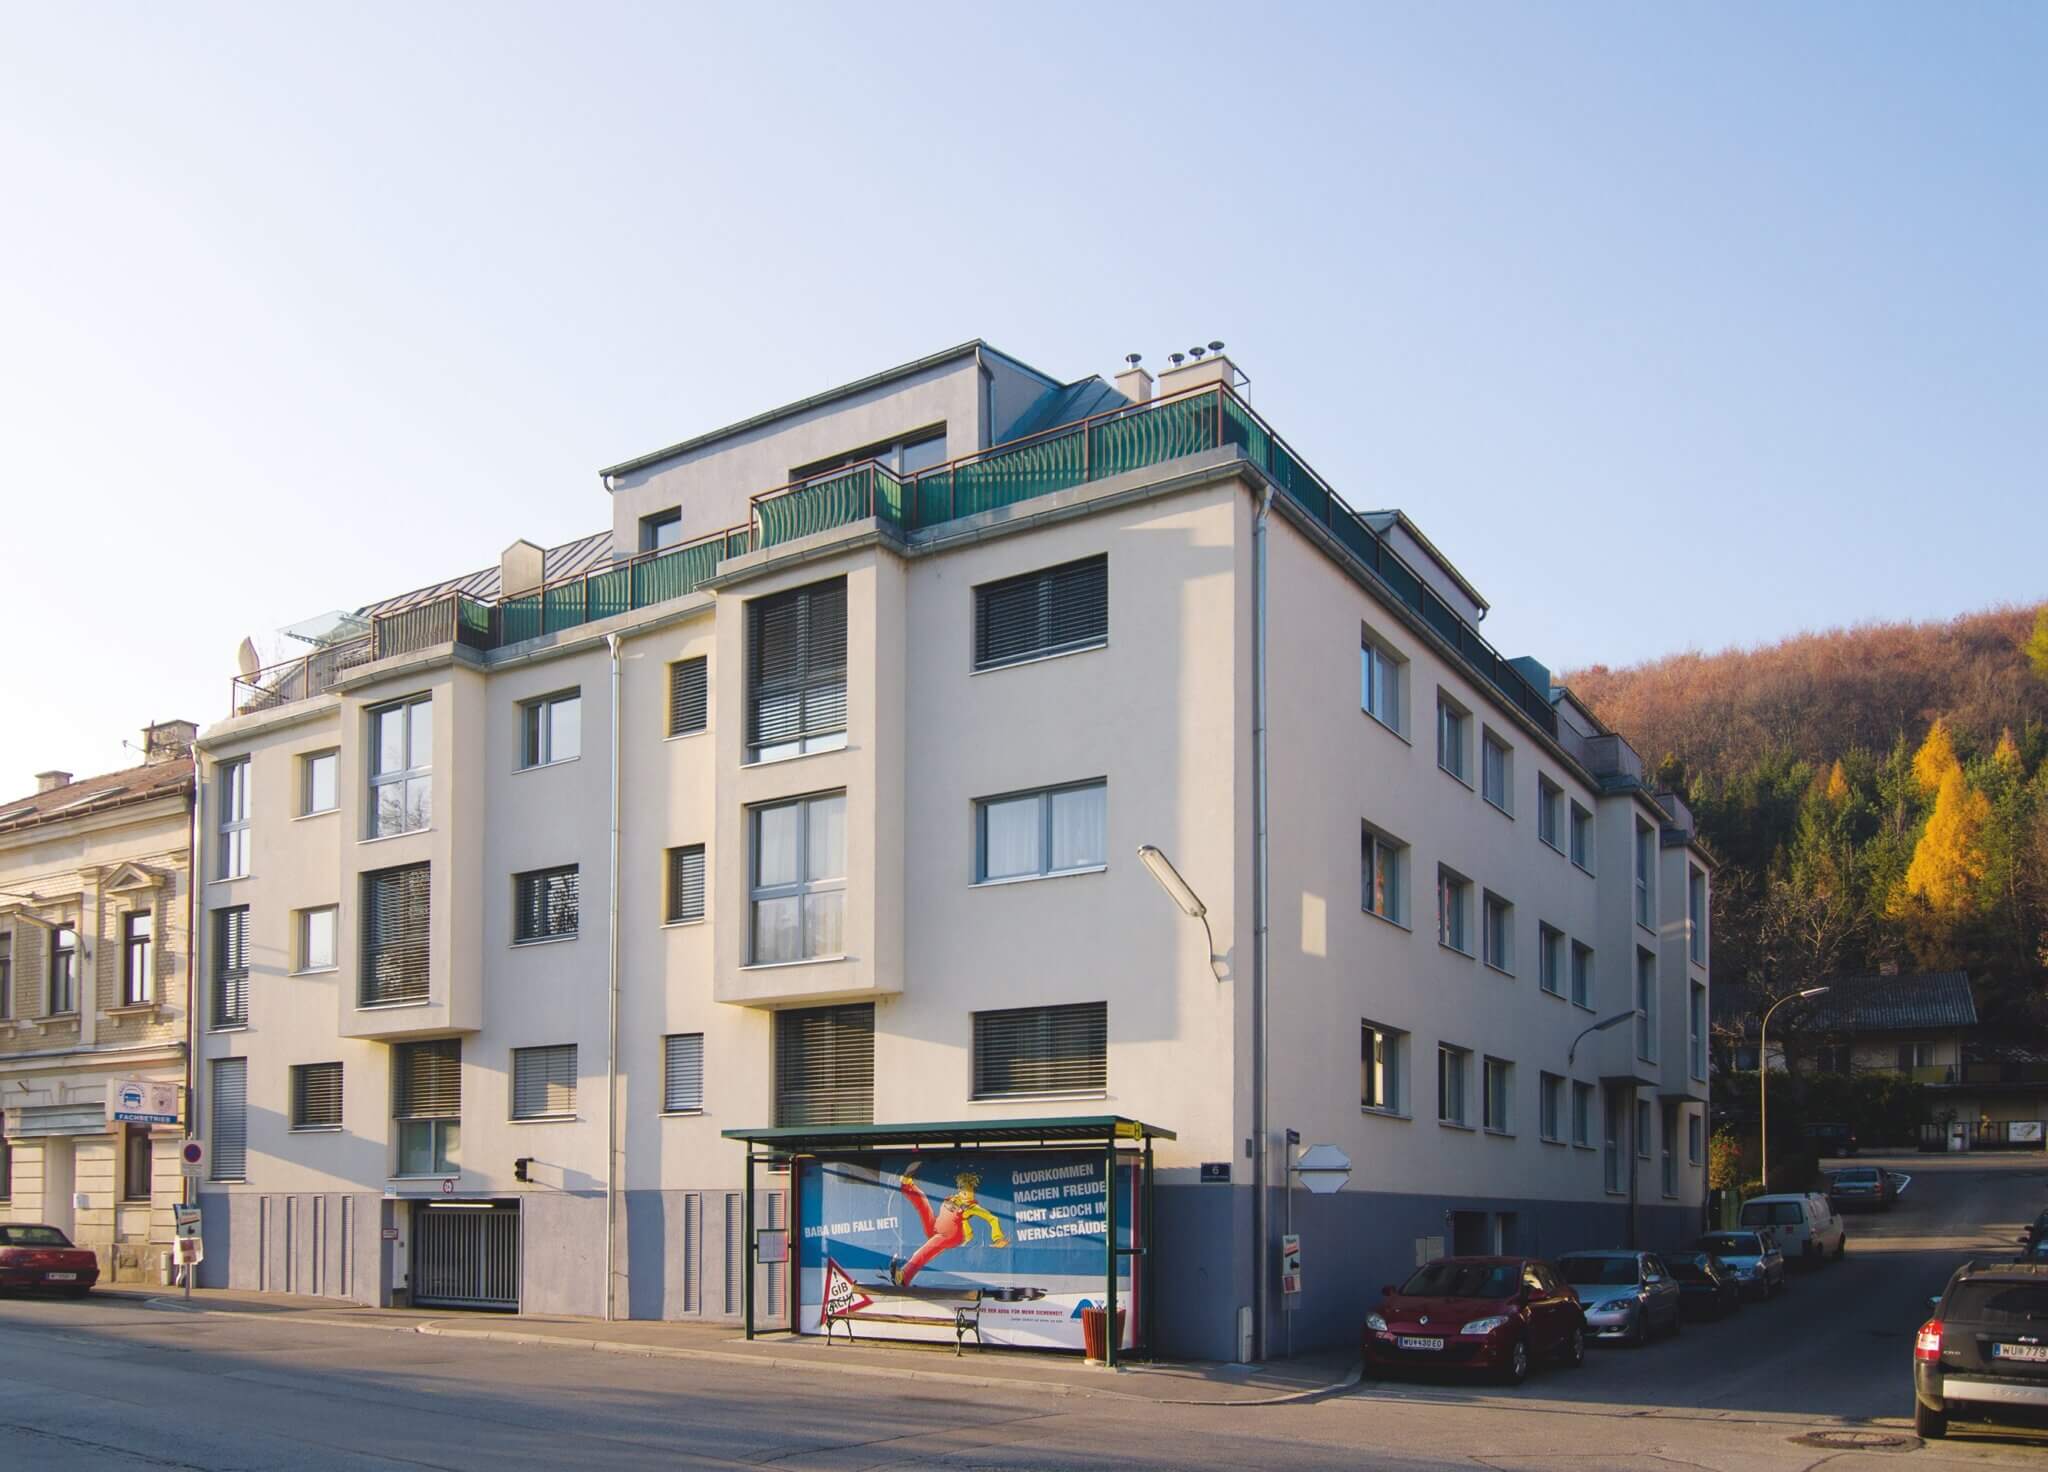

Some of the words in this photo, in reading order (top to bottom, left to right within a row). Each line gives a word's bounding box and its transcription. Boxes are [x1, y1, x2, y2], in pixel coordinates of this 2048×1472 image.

[119, 1113, 171, 1122] FACHBETRIEB
[1012, 1163, 1094, 1185] ÖLVORKOMMEN
[1013, 1187, 1060, 1204] MACHEN
[1063, 1181, 1107, 1198] FREUDE
[1015, 1208, 1047, 1223] NICHT
[1049, 1202, 1092, 1219] JEDOCH
[804, 1224, 830, 1238] BABA
[831, 1222, 850, 1235] UND
[853, 1219, 876, 1233] FALL
[876, 1216, 898, 1230] NET!
[1016, 1220, 1108, 1242] WERKSGEBÄUDE
[831, 1281, 849, 1297] GIB
[2002, 1343, 2017, 1356] WU
